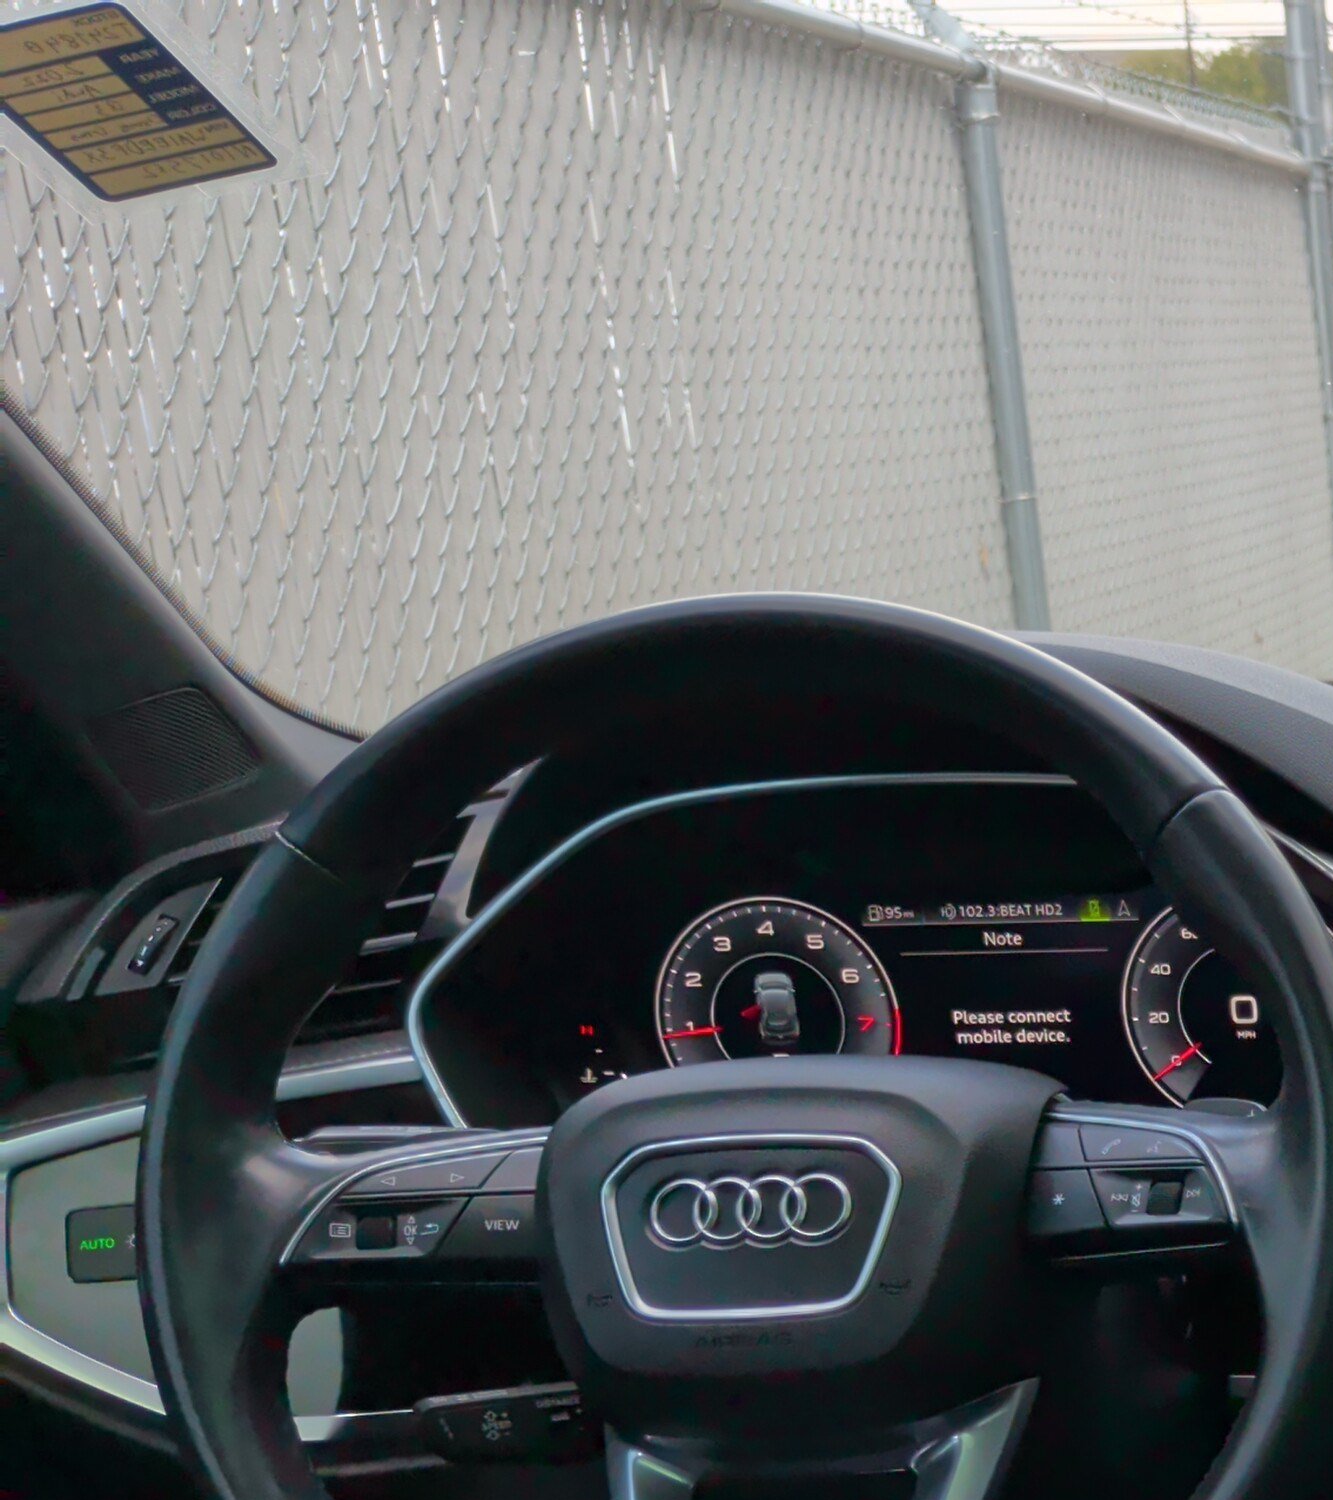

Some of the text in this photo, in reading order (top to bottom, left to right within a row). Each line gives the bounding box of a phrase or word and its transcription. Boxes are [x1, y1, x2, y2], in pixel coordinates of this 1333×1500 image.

[1035, 904, 1063, 916] HD2
[757, 921, 774, 935] 4
[713, 937, 732, 952] 3
[806, 934, 824, 950] 5
[983, 932, 1023, 946] Note
[841, 968, 860, 984] 6
[1150, 964, 1171, 975] 40
[685, 972, 703, 988] 2
[953, 1009, 1071, 1024] Please connect
[1230, 995, 1258, 1024] 0
[857, 1016, 875, 1032] 7
[1149, 1012, 1169, 1024] 20
[957, 1029, 1071, 1044] mobile device.
[1236, 1030, 1256, 1039] MPH
[403, 1225, 418, 1236] OK
[484, 1219, 520, 1231] VIEW
[80, 1237, 115, 1251] AUTO
